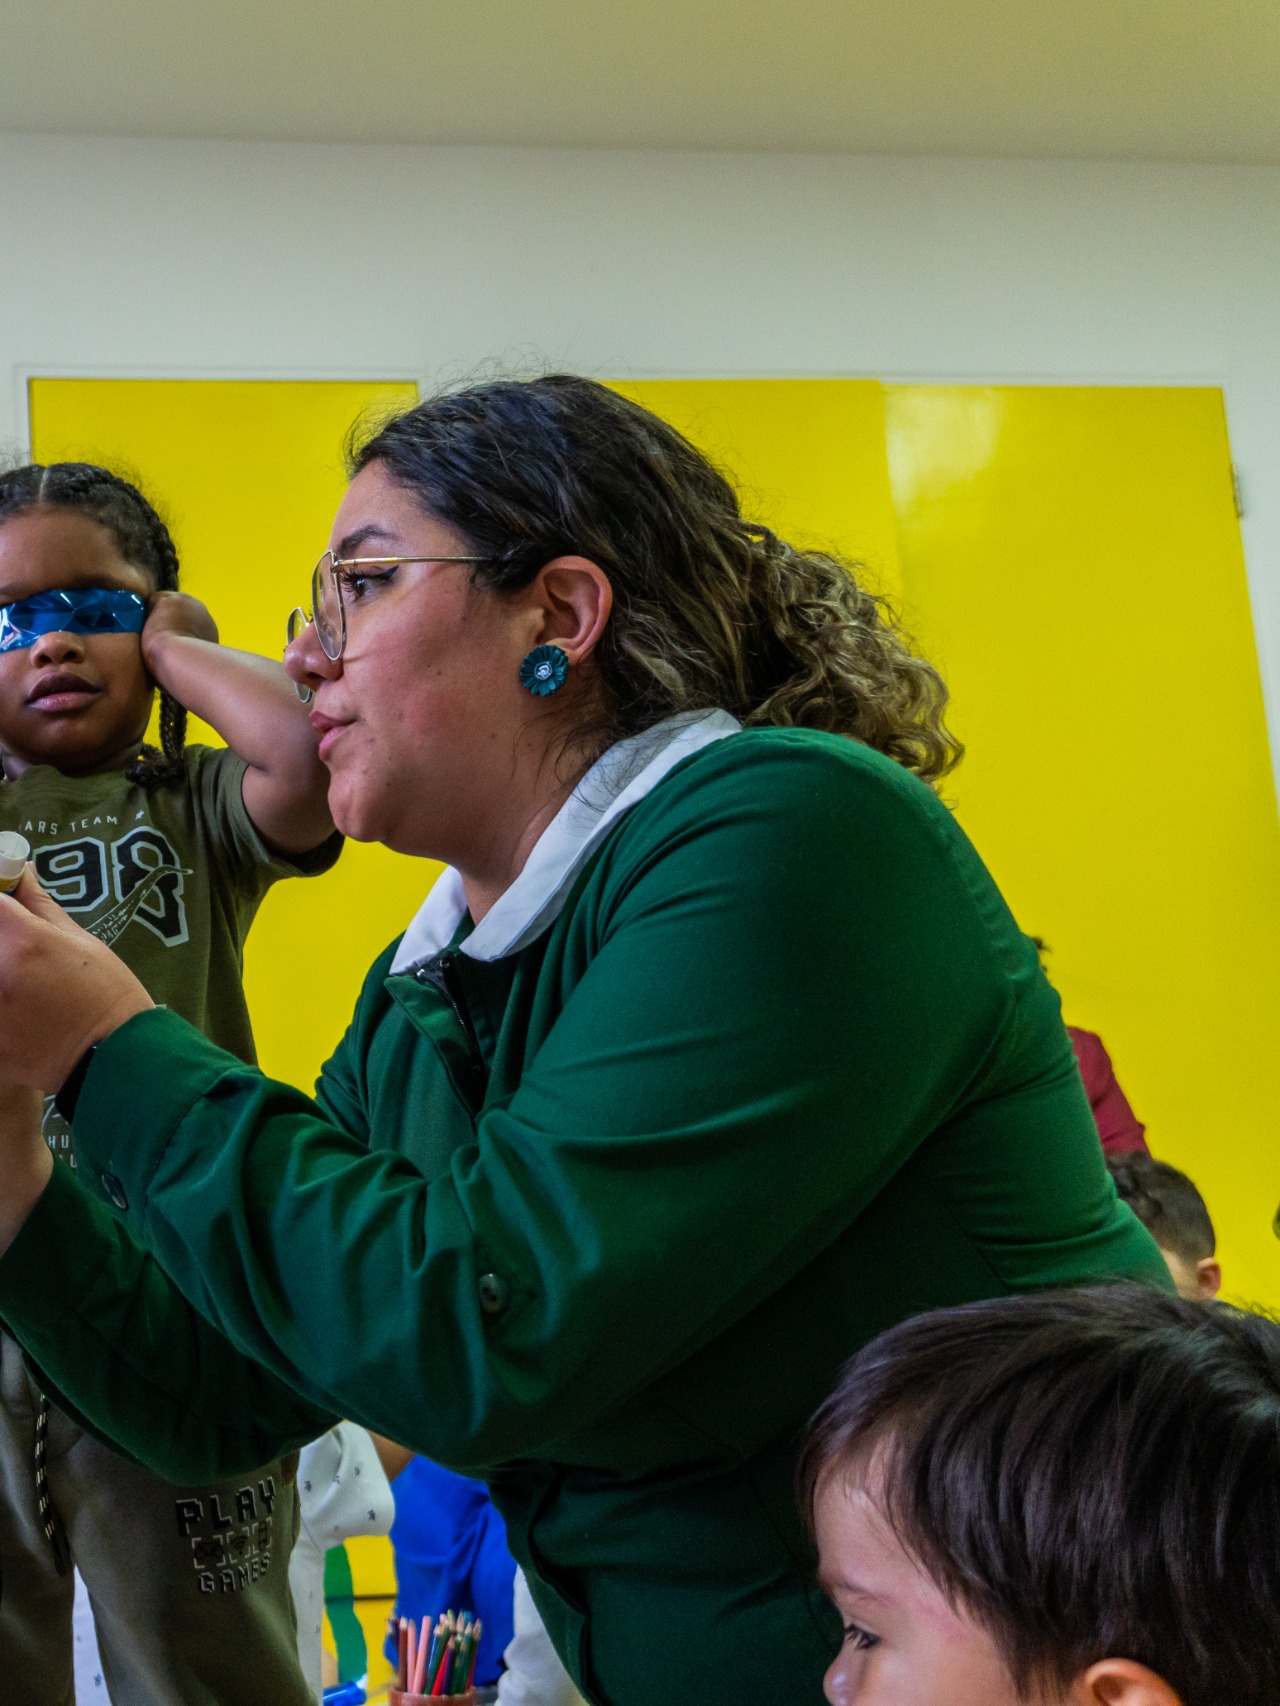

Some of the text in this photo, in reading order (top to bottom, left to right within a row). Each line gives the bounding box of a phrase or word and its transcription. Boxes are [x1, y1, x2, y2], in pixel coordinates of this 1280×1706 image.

[70, 815, 118, 833] TEAM
[175, 1476, 276, 1537] PLAY
[198, 1552, 272, 1594] GAMES
